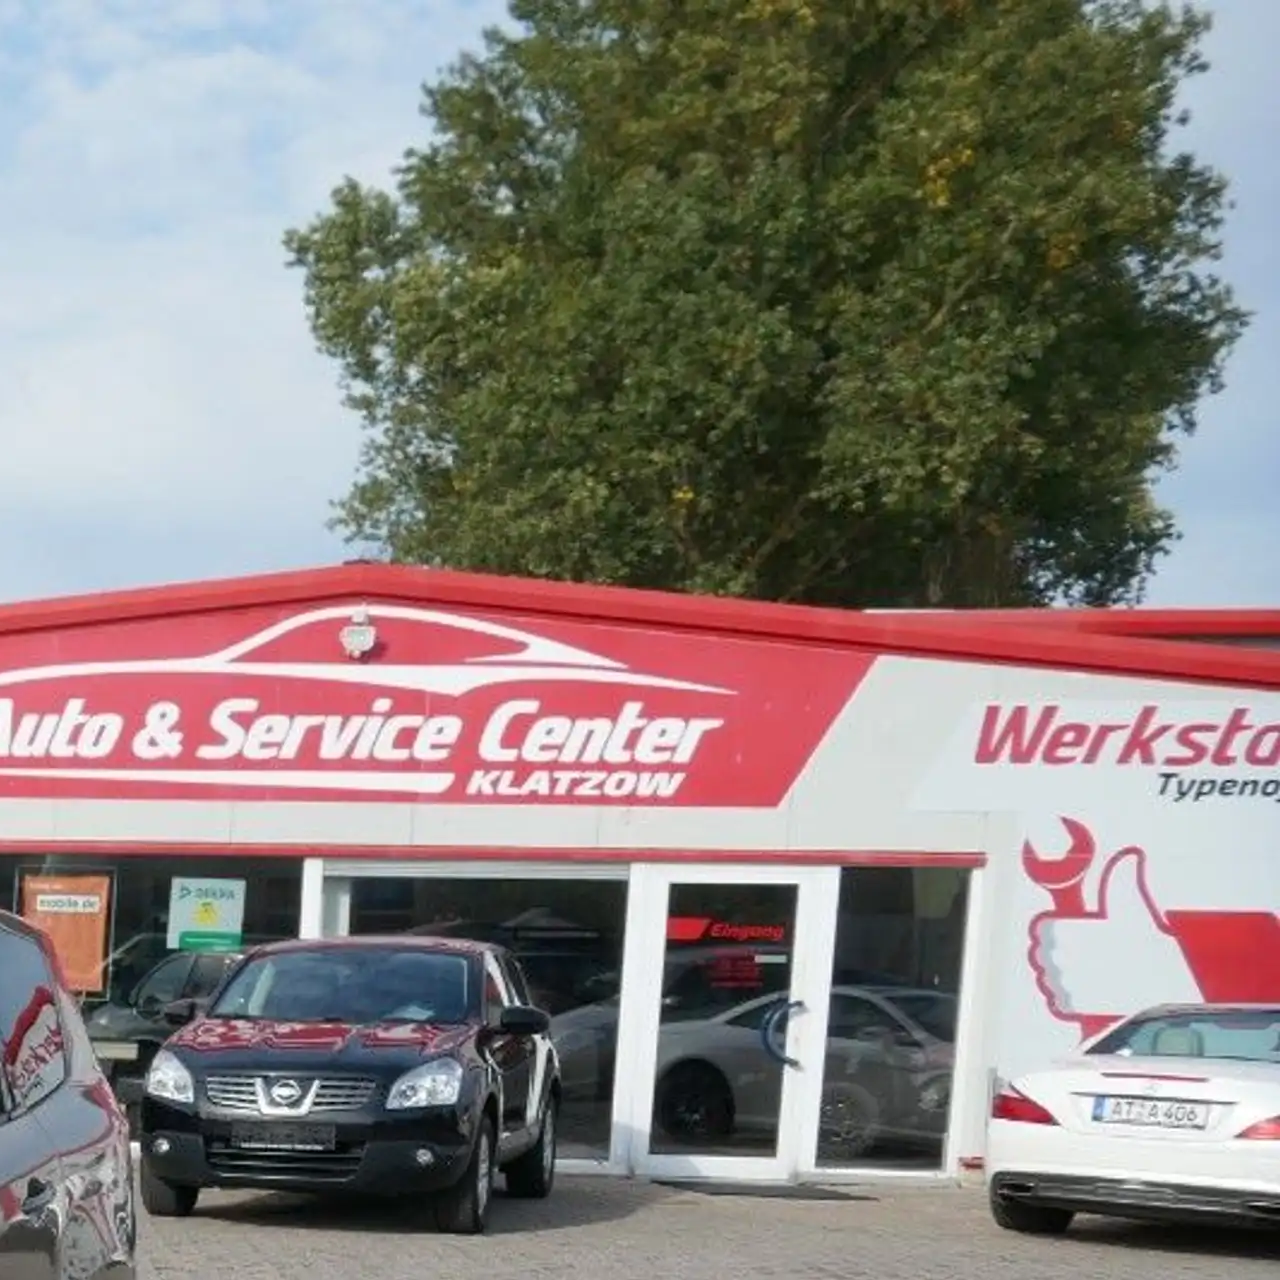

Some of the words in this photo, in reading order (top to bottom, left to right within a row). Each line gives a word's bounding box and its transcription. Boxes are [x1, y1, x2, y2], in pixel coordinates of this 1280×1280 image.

[132, 701, 184, 759] &
[195, 697, 463, 761] Service
[478, 699, 724, 764] Center
[466, 769, 686, 797] KLATZOW
[1158, 772, 1280, 802] Typeno
